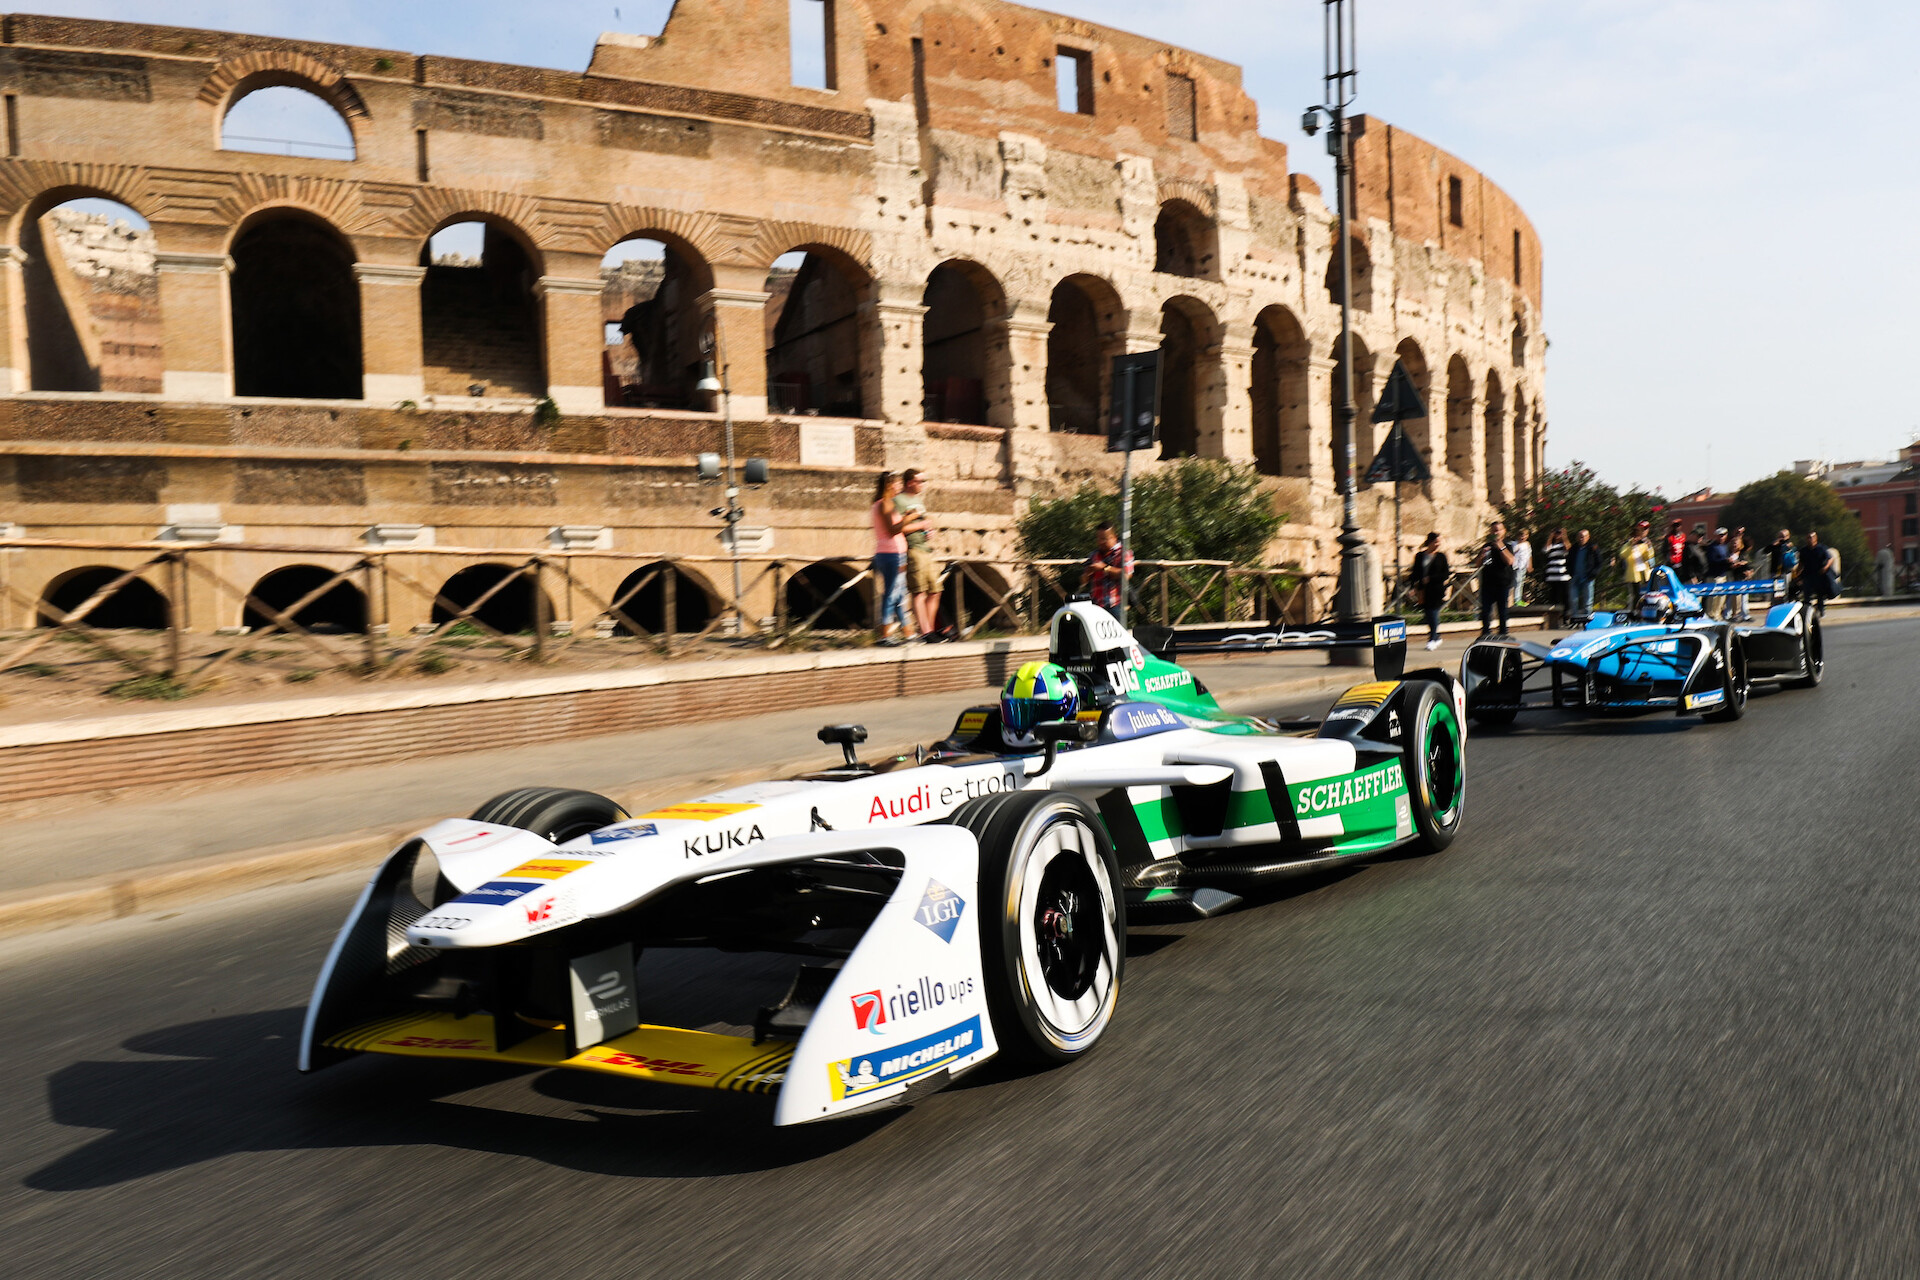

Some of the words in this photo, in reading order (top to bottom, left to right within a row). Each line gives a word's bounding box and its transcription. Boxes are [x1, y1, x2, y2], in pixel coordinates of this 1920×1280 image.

[1132, 649, 1142, 665] E
[1144, 670, 1192, 693] SCHAEFFLER
[1127, 710, 1161, 734] Julius
[868, 784, 931, 824] Audi
[940, 770, 1017, 806] e-tron
[1296, 763, 1403, 814] SCHAEFFLER
[684, 824, 765, 859] KUKA
[920, 897, 961, 927] LGT
[889, 976, 945, 1021] riello
[949, 976, 974, 1004] ups
[600, 1052, 706, 1077] DHL
[879, 1029, 974, 1077] MICHELIN
